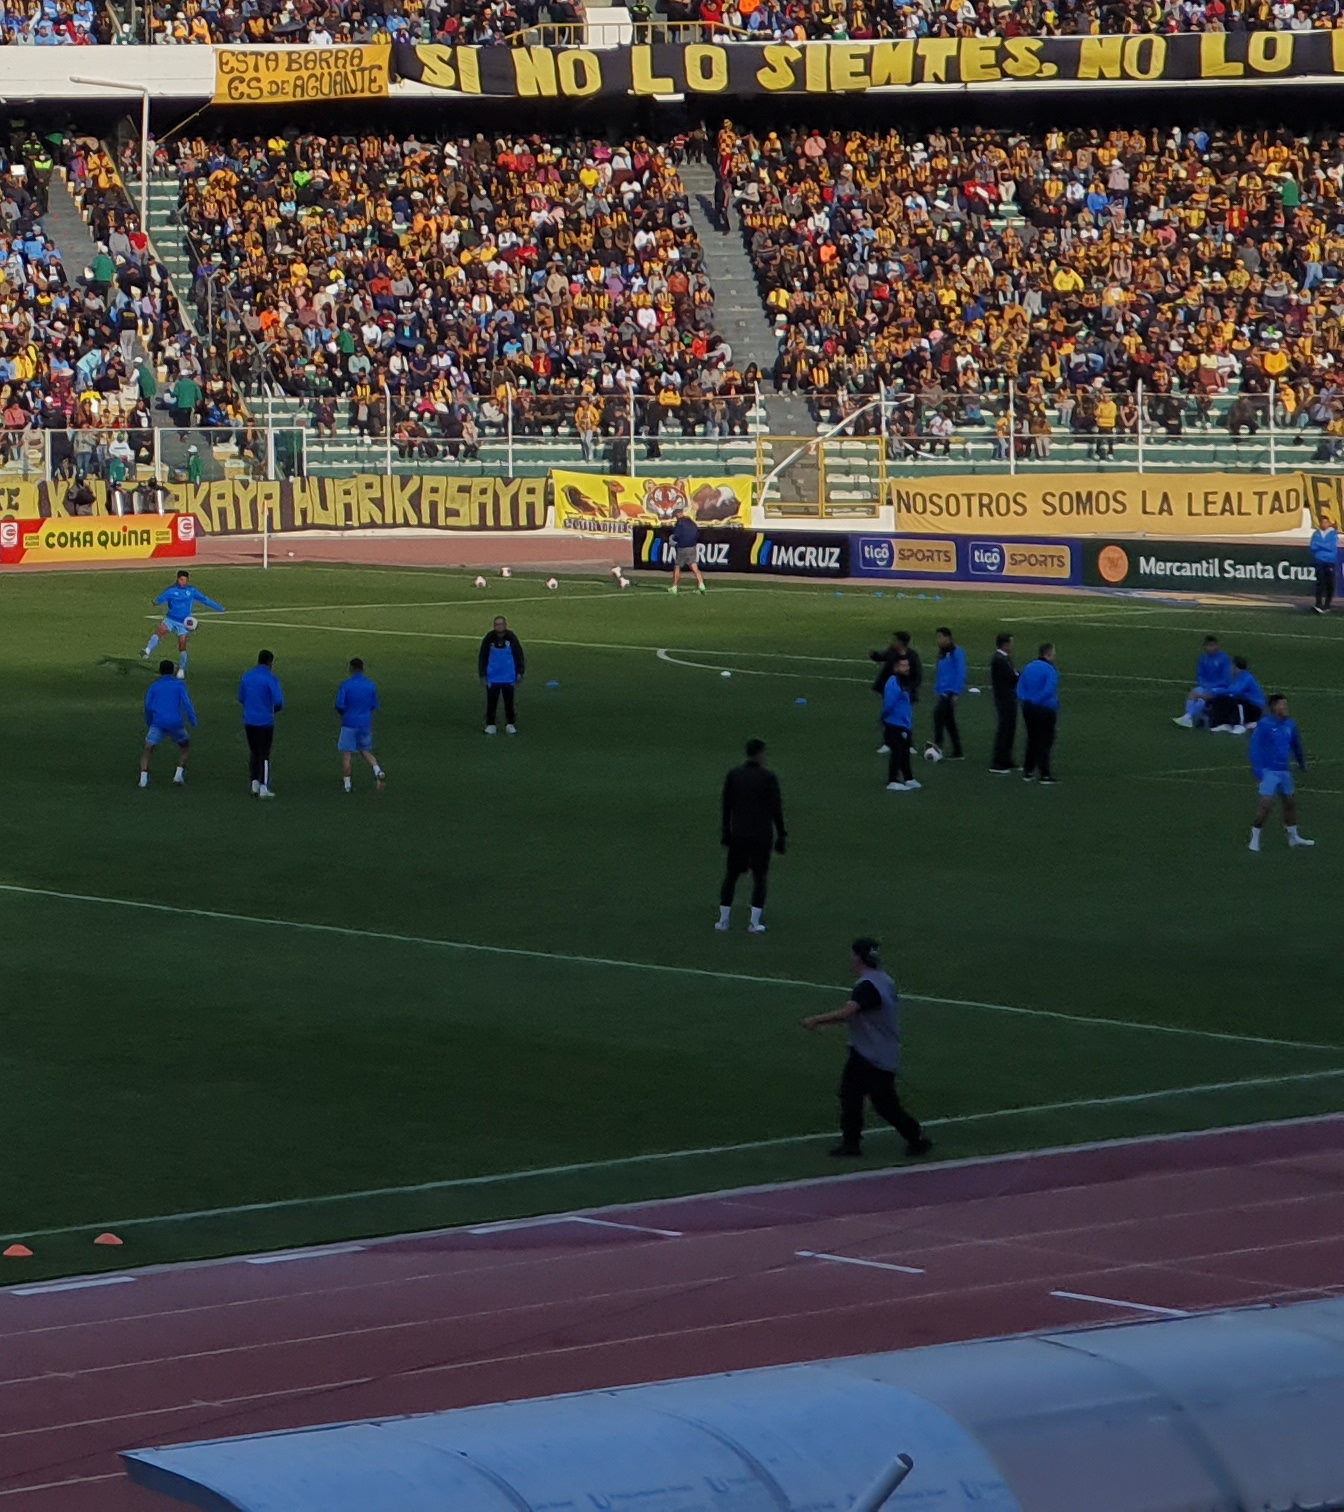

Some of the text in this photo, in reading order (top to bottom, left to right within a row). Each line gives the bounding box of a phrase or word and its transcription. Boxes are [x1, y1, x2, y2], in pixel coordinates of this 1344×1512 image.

[218, 48, 363, 74] ESTA BARRA
[416, 44, 480, 94] SI
[512, 47, 603, 97] NO
[631, 44, 728, 95] LO
[1078, 34, 1167, 79] NO
[1200, 31, 1293, 77] LO
[227, 64, 384, 100] ES DE AGUANTE
[292, 474, 548, 527] HUARIKASAYA
[896, 489, 1028, 517] NOSOTROS
[1042, 489, 1127, 517] SOMOS
[1141, 490, 1174, 516] LA
[1187, 487, 1301, 517] LEALTAD
[44, 531, 93, 549] COKA
[663, 543, 729, 565] IMRUZ
[772, 545, 840, 568] IMCRUZ
[898, 548, 952, 563] SPORTS
[1009, 553, 1065, 568] SPORTS
[1139, 556, 1220, 578] Mercantil
[1223, 558, 1274, 580] Santa
[1278, 561, 1318, 581] Cruz
